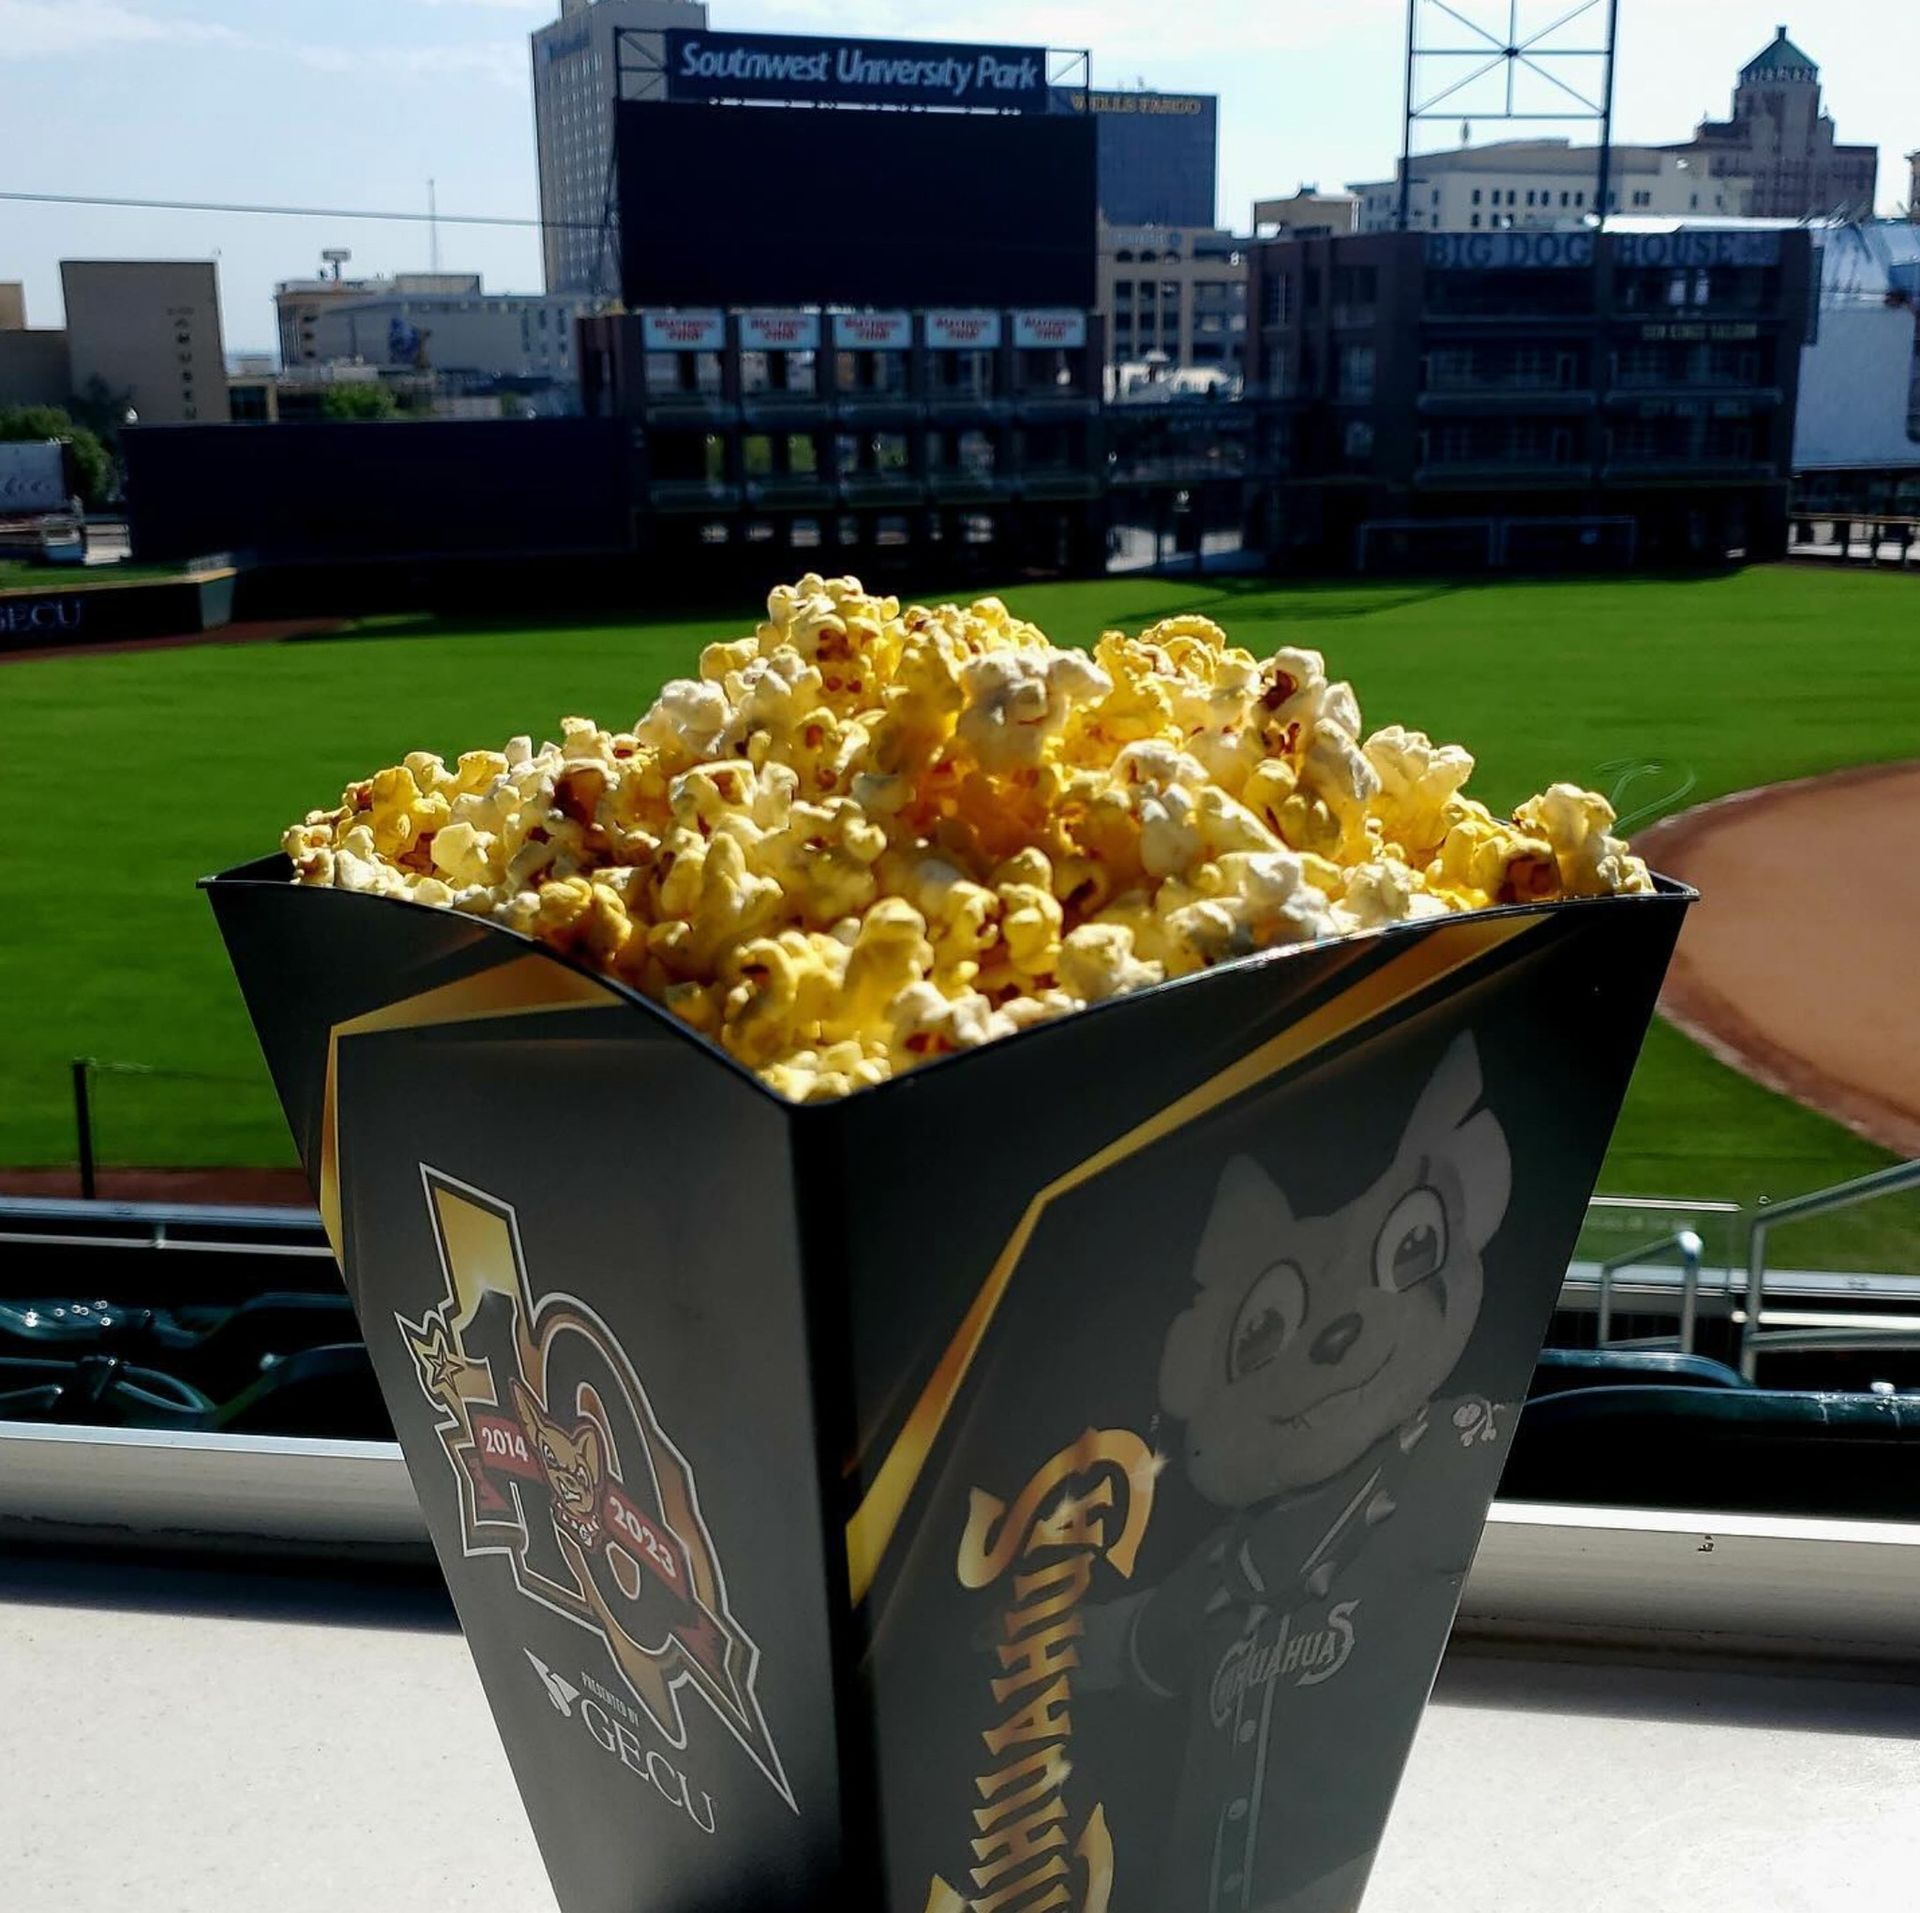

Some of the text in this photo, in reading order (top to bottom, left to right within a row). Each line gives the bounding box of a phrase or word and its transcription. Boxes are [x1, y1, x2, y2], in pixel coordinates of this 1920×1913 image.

[680, 42, 1039, 95] Southwest University Park
[1428, 233, 1735, 267] BIG DOG HOUSE
[482, 1427, 529, 1462] 2014
[610, 1497, 676, 1578] 2023
[581, 1700, 715, 1833] GECU
